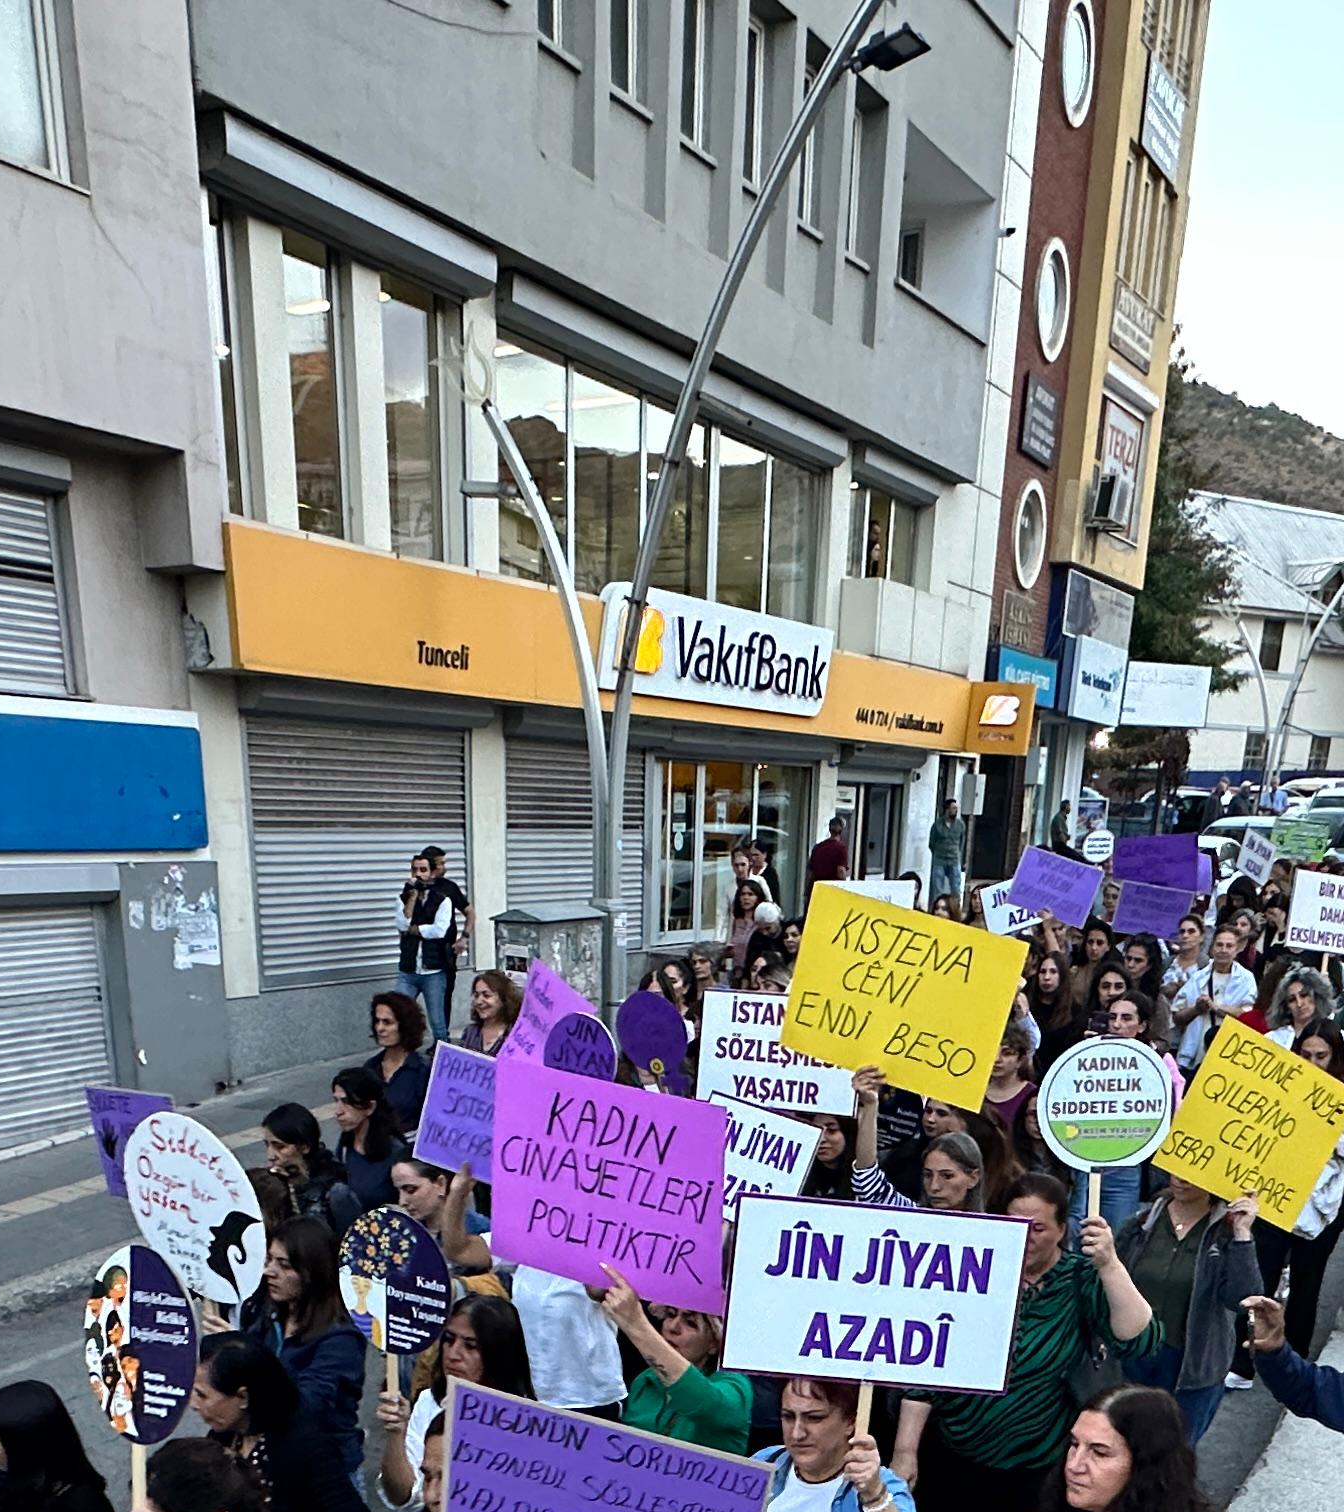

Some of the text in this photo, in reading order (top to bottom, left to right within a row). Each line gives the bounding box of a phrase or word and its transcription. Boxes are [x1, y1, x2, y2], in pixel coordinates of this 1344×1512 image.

[417, 640, 470, 671] Tunceli
[1319, 879, 1336, 897] BİR
[831, 908, 974, 983] KISTENA
[883, 1023, 976, 1077] BESO
[1077, 1056, 1139, 1072] KADINA
[733, 1074, 820, 1104] YAŞATIR
[1051, 1097, 1162, 1118] ŞİDDETE SON!
[1073, 1074, 1142, 1093] YÖNELİK
[546, 1091, 677, 1165] KADIN
[500, 1136, 715, 1225] CİNAYETLERİ
[526, 1198, 704, 1285] POLİTİKTİR
[764, 1220, 994, 1295] JÎN JÎYAN
[416, 1276, 446, 1293] Kadın
[798, 1312, 955, 1368] AZADÎ
[452, 1433, 568, 1490] İSTANBUL
[458, 1393, 770, 1501] BUGÜNÜN SORUMLUSU
